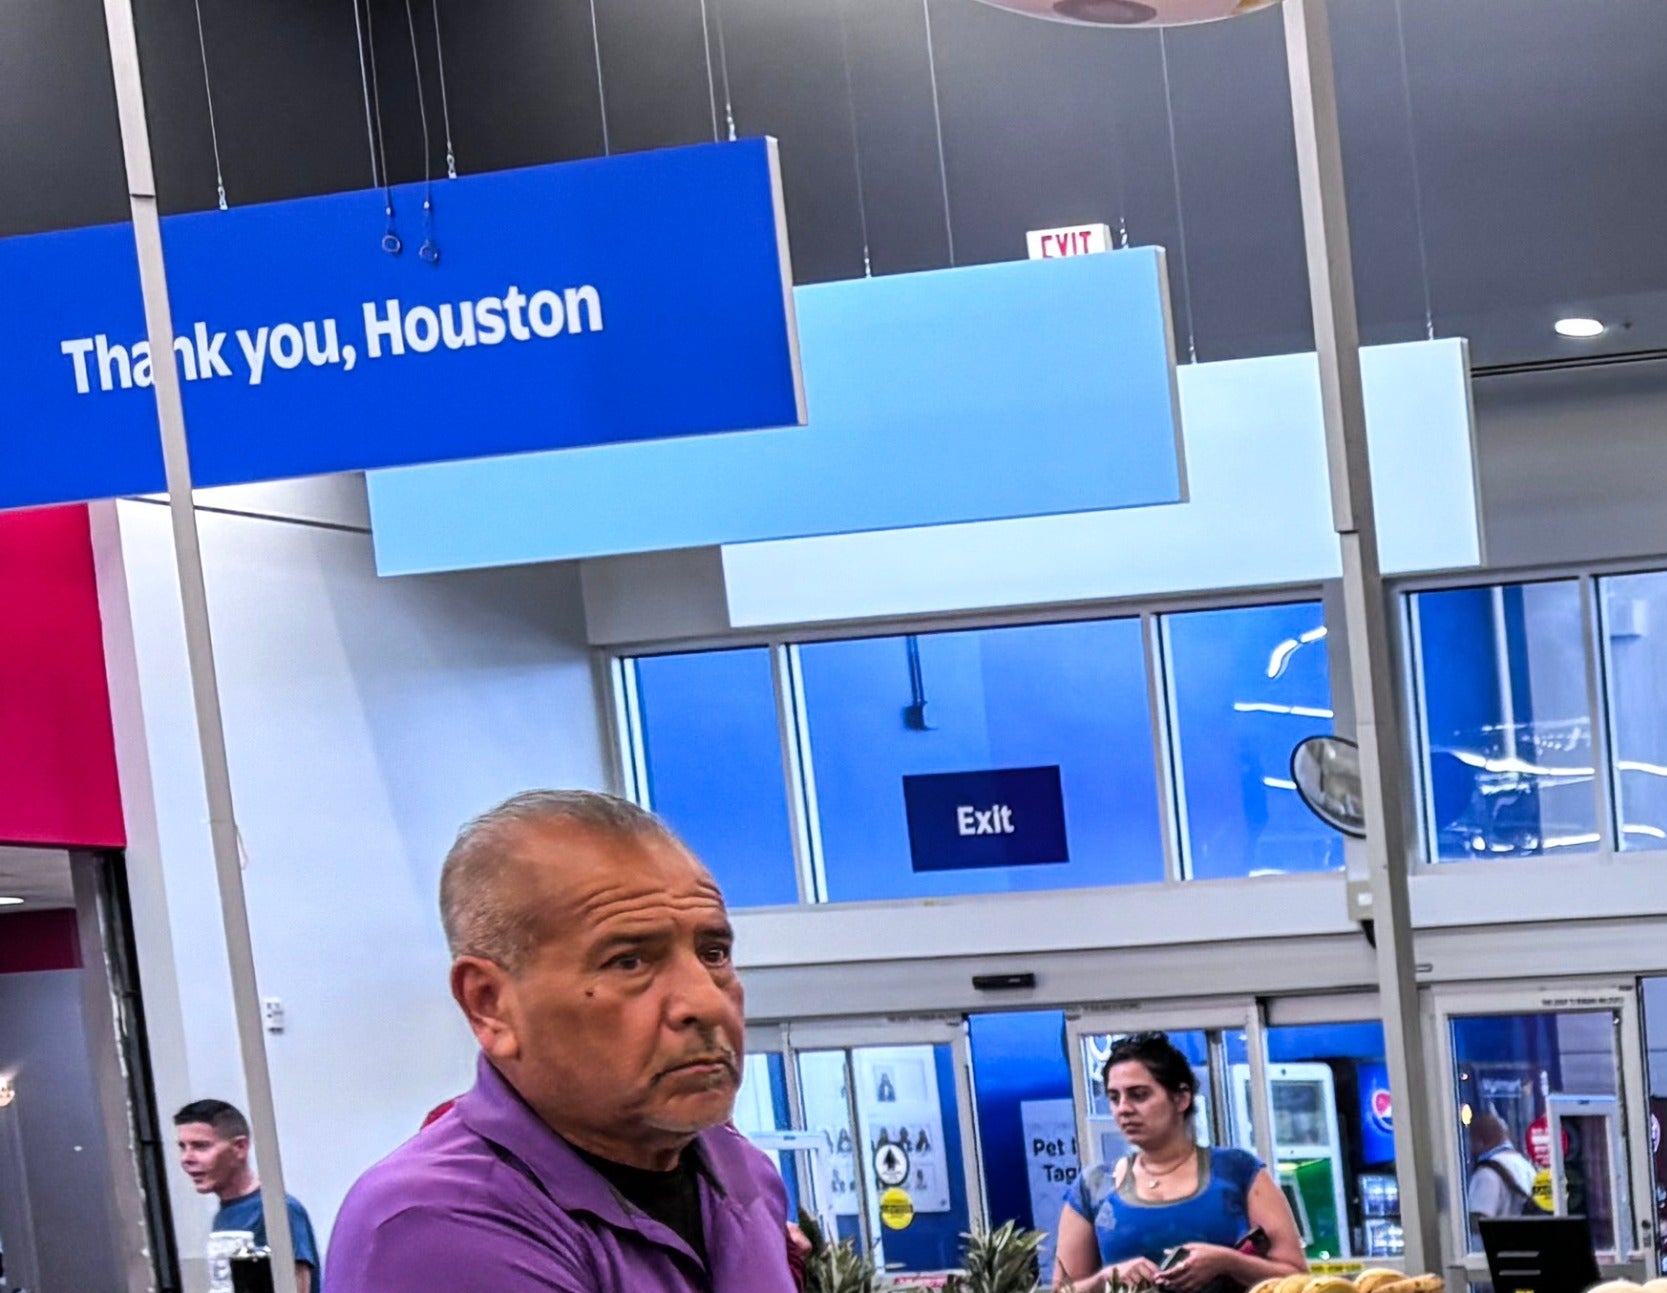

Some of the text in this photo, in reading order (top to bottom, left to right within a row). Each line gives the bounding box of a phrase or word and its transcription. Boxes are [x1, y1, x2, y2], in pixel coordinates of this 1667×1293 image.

[61, 284, 603, 394] Thank you, Houston
[957, 804, 1015, 836] Exit
[1033, 1138, 1065, 1156] Pet
